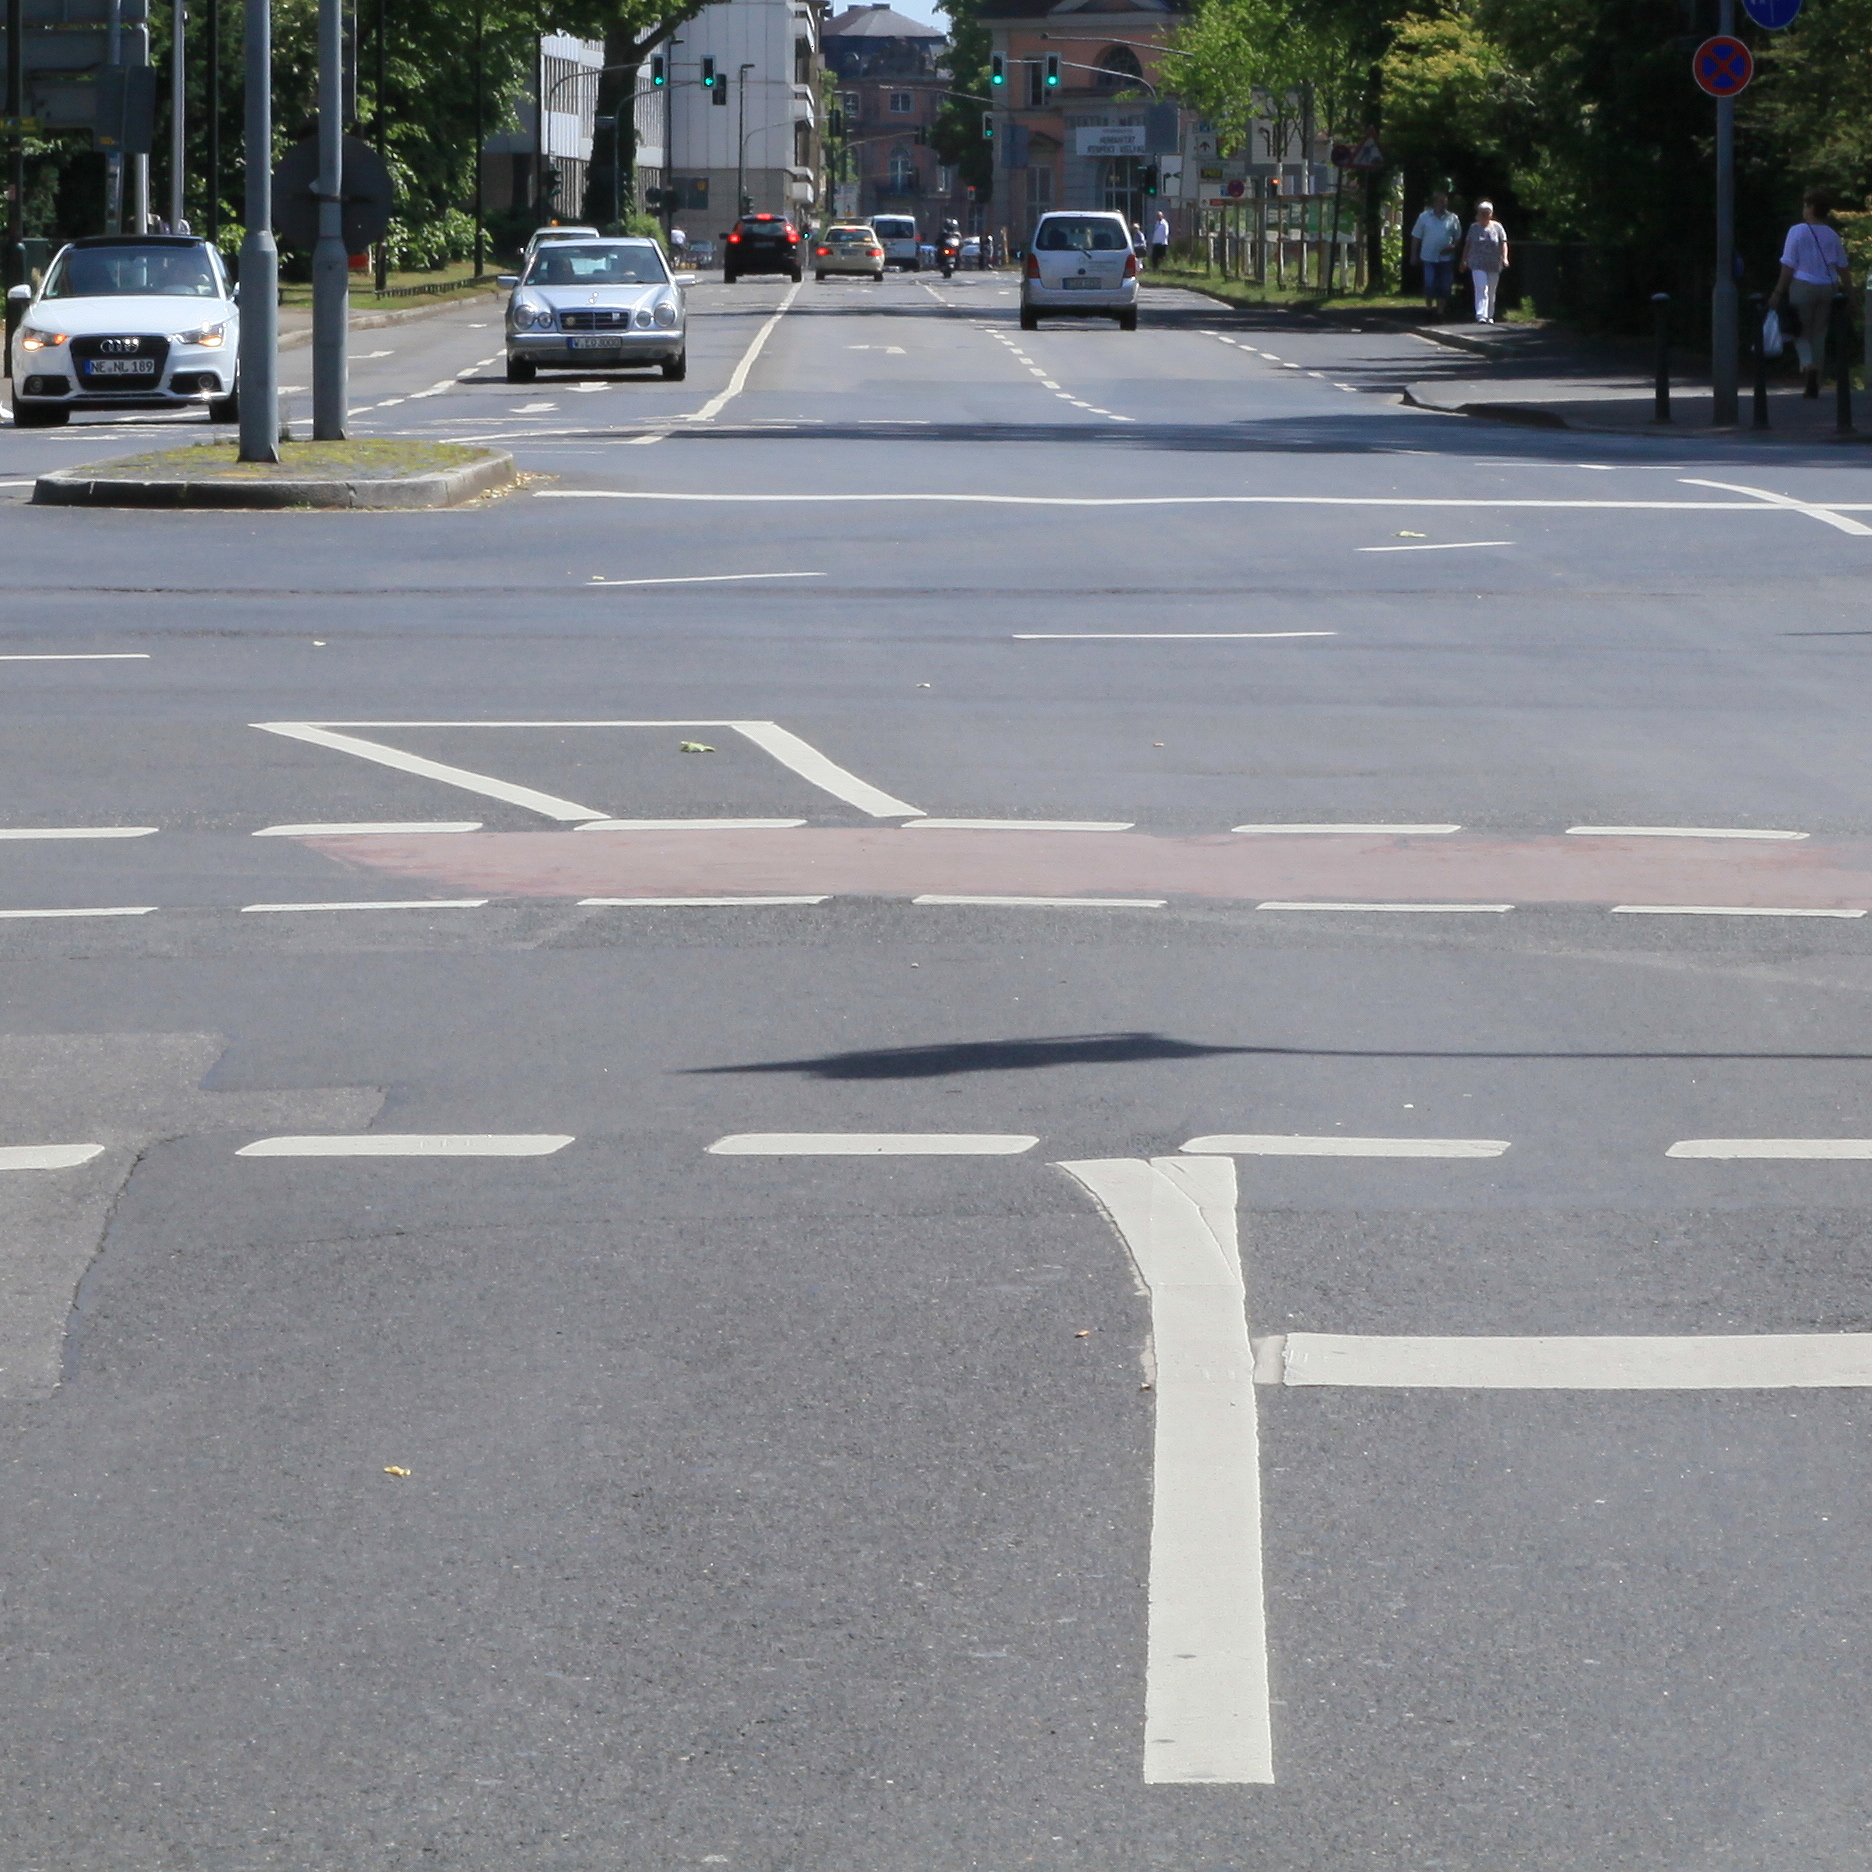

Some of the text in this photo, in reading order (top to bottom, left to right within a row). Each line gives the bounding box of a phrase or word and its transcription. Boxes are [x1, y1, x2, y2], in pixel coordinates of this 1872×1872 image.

[90, 360, 153, 373] NE NL 189
